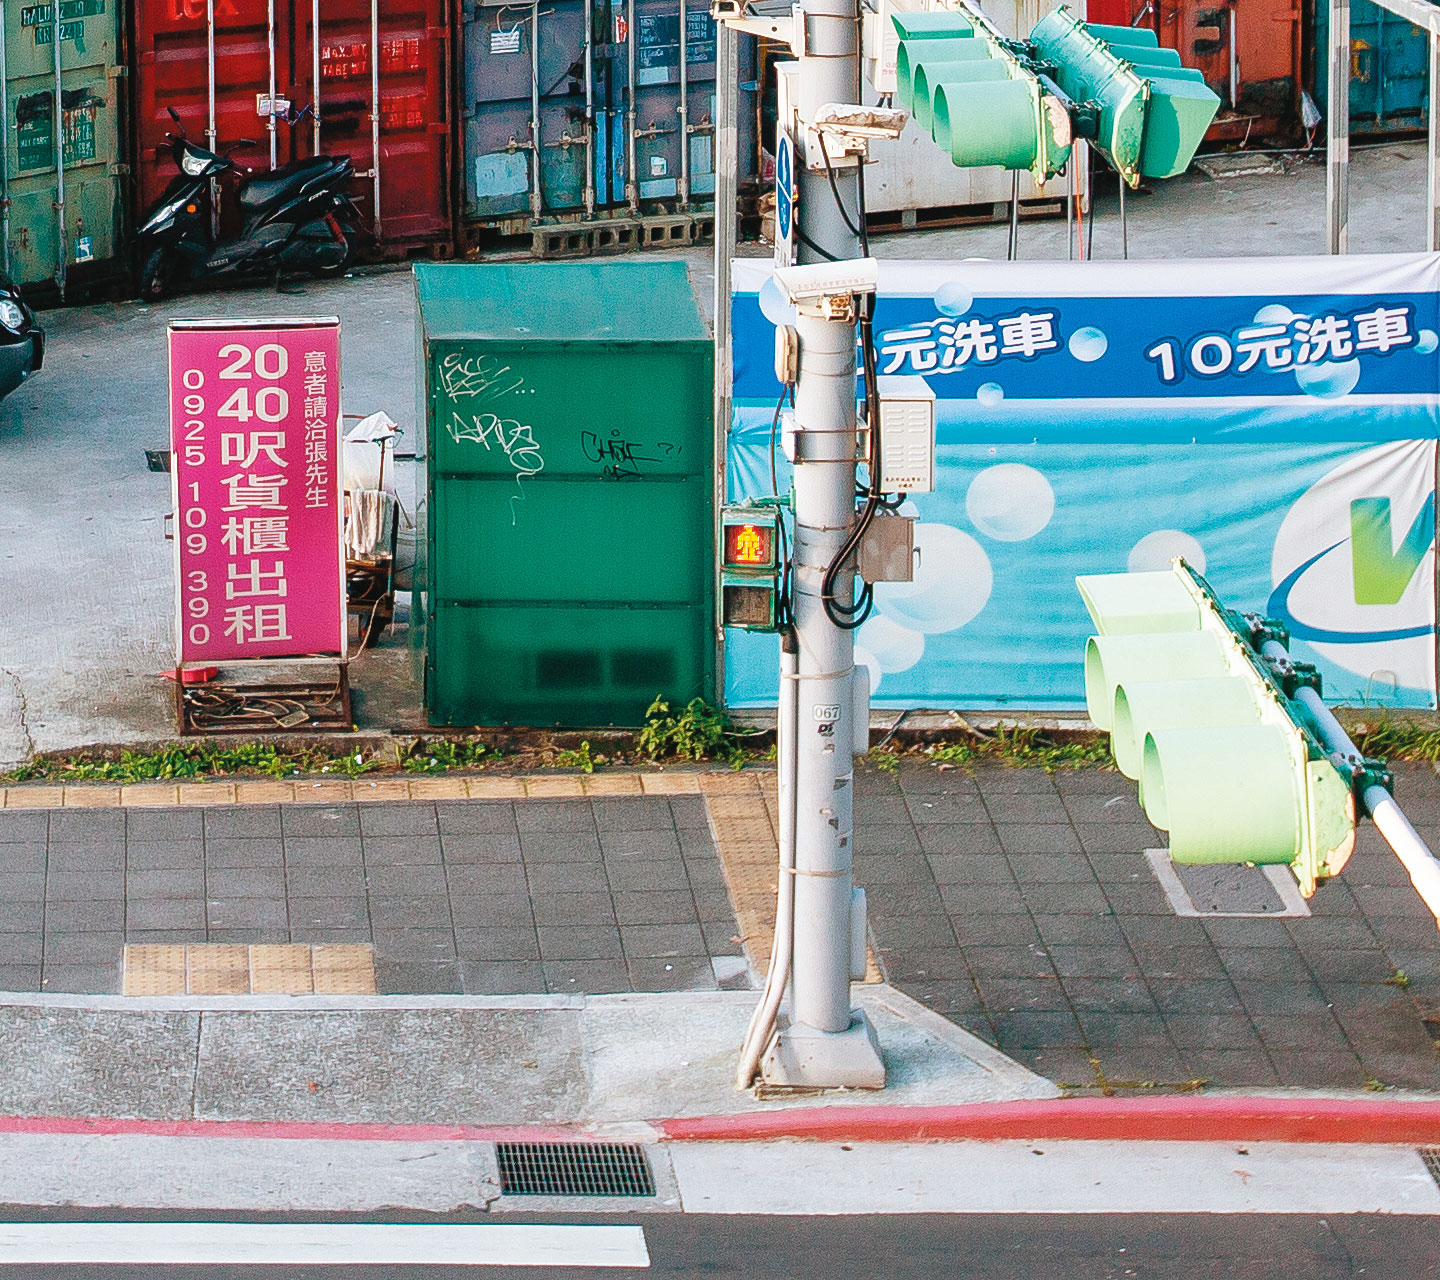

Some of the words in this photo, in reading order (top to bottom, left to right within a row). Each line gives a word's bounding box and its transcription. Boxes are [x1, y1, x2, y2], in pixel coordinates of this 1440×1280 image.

[217, 342, 290, 381] 20
[856, 310, 1060, 377] 元洗車
[1147, 305, 1416, 383] 10元洗車
[216, 386, 290, 424] 40
[302, 349, 329, 510] 意者請洽張先生
[219, 428, 293, 645] 呎貨櫃出租
[814, 706, 840, 720] 067
